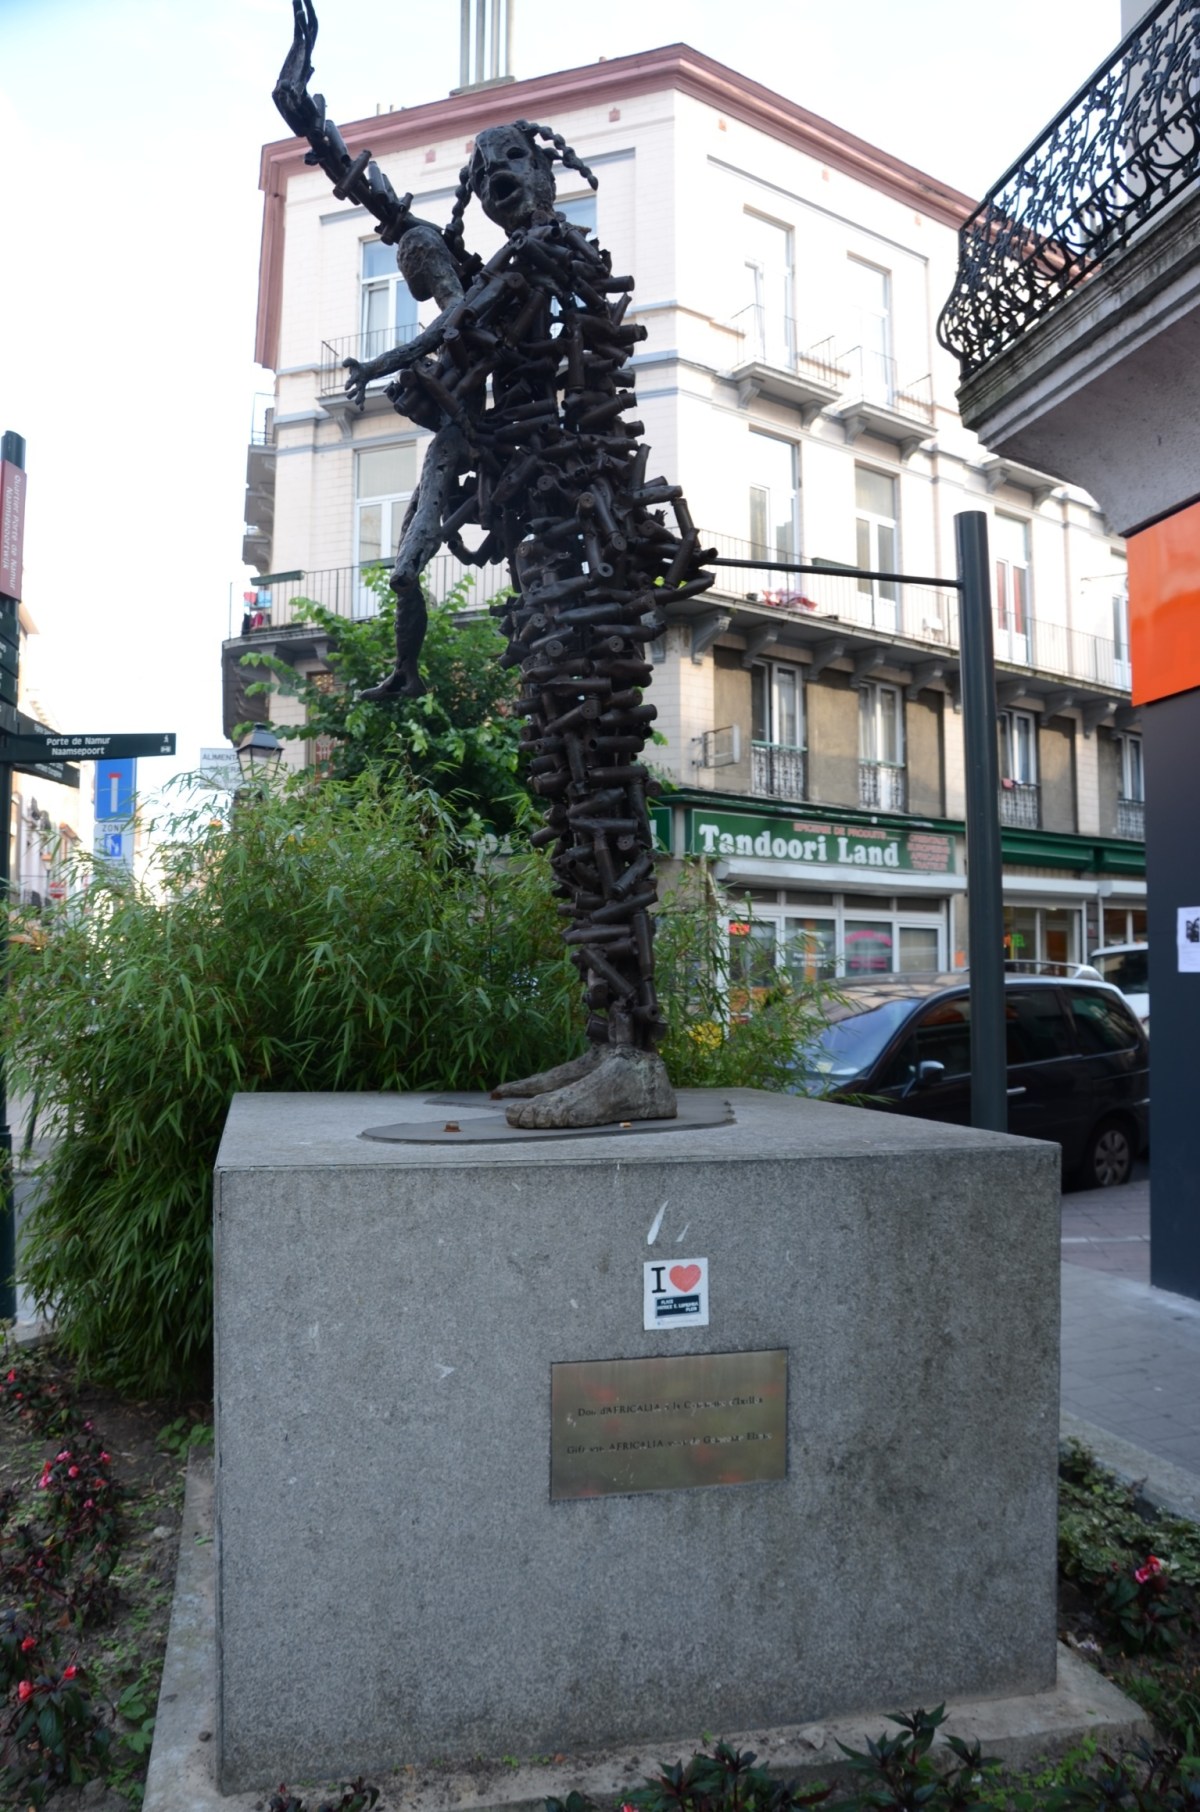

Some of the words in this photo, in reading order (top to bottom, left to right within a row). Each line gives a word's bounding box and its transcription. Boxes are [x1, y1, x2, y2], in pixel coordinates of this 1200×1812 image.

[13, 475, 21, 513] Quartier
[9, 558, 17, 590] Namur
[46, 737, 69, 746] Porte
[71, 737, 82, 745] de
[84, 736, 111, 745] Namur
[51, 747, 105, 756] Naamsepoort
[699, 823, 828, 862] Tandoori
[837, 836, 900, 868] Land
[651, 1266, 666, 1293] I
